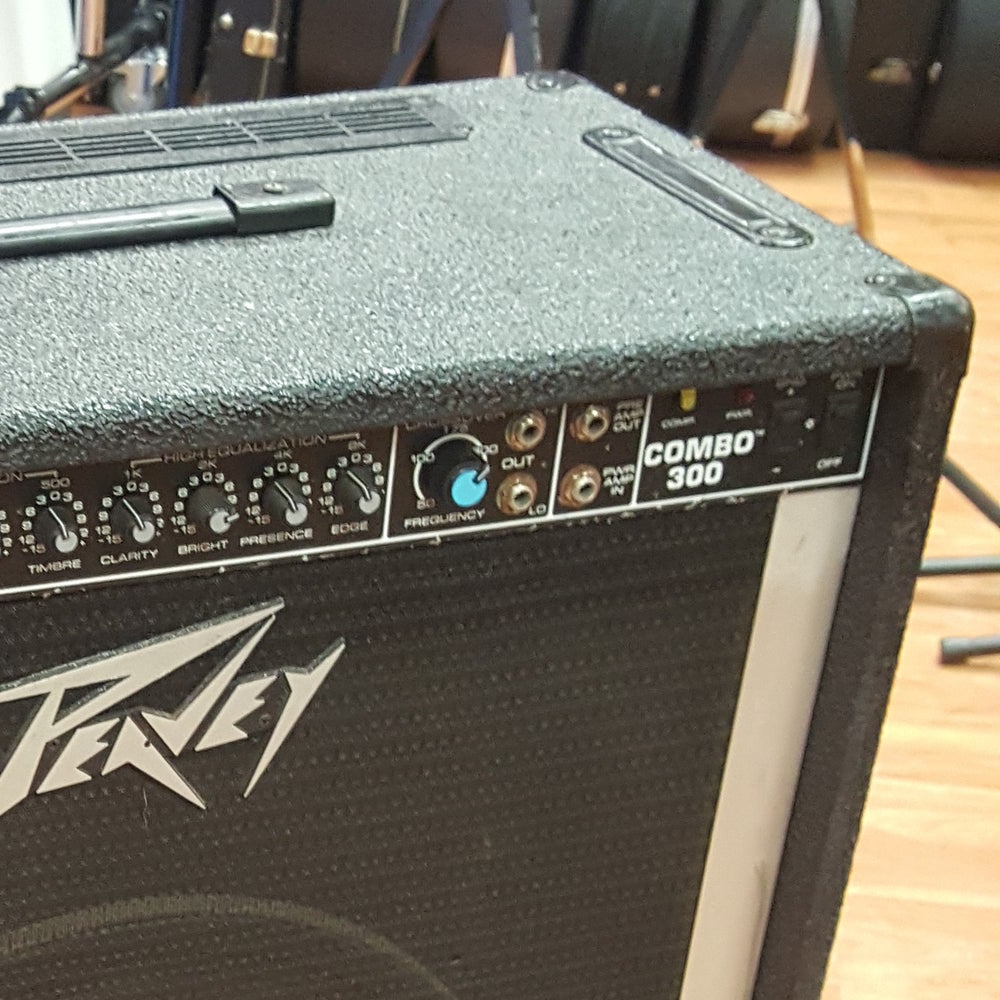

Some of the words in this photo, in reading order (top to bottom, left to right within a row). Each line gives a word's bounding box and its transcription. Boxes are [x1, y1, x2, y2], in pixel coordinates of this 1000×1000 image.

[612, 418, 642, 432] OUT
[643, 430, 755, 467] COMBO
[351, 452, 361, 463] 0
[501, 454, 535, 470] OUT
[277, 462, 287, 472] 0
[202, 471, 213, 482] 0
[666, 460, 724, 491] 300
[126, 481, 137, 492] 0
[610, 485, 625, 496] IN
[49, 490, 61, 501] 0
[528, 503, 546, 517] LO
[404, 508, 486, 529] FREQUENCY
[331, 520, 369, 535] EDGE
[240, 528, 313, 547] PRESENCE
[177, 539, 229, 555] BRIGHT
[100, 548, 159, 565] CLARITY
[27, 559, 81, 575] TIMBRE
